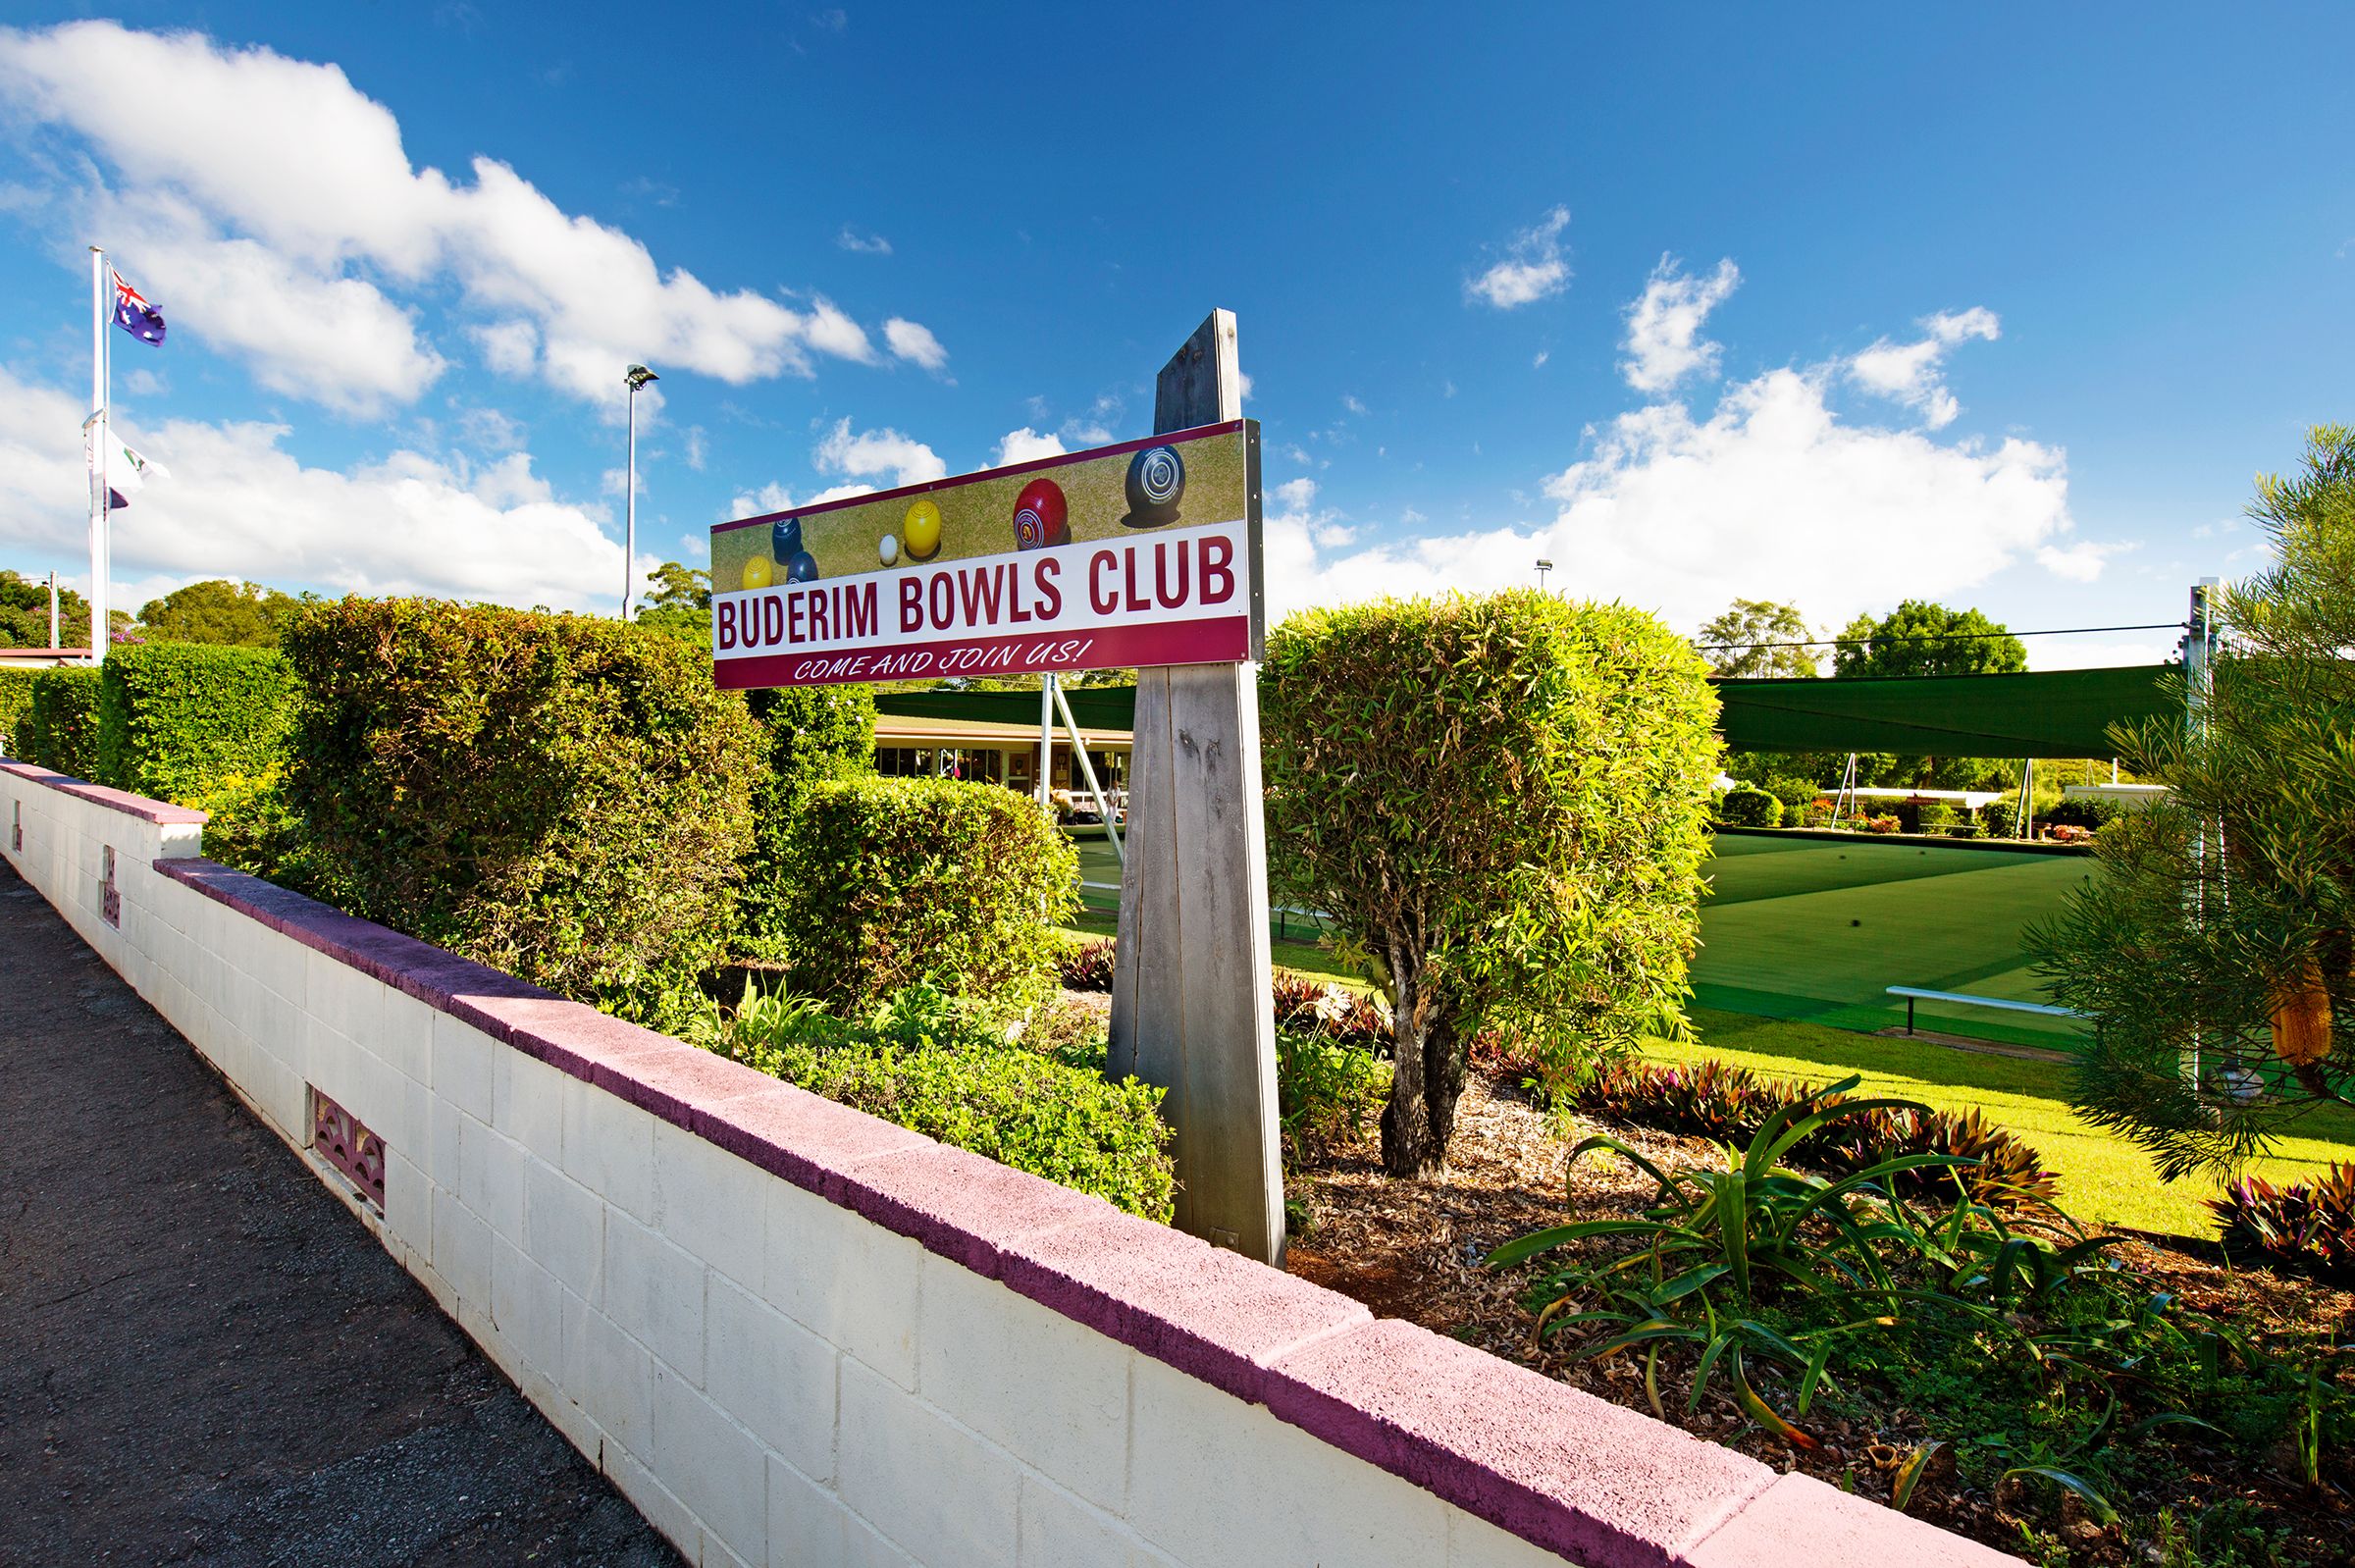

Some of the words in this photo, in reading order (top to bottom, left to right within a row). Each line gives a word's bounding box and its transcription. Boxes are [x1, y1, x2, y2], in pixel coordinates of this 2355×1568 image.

[718, 582, 878, 651] BUDERIM
[899, 556, 1062, 634] BOWLS
[1089, 535, 1235, 616] CLUB
[794, 655, 871, 680] COME
[869, 652, 934, 675] AND
[938, 643, 1022, 670] JOIN
[1025, 639, 1094, 665] US!
